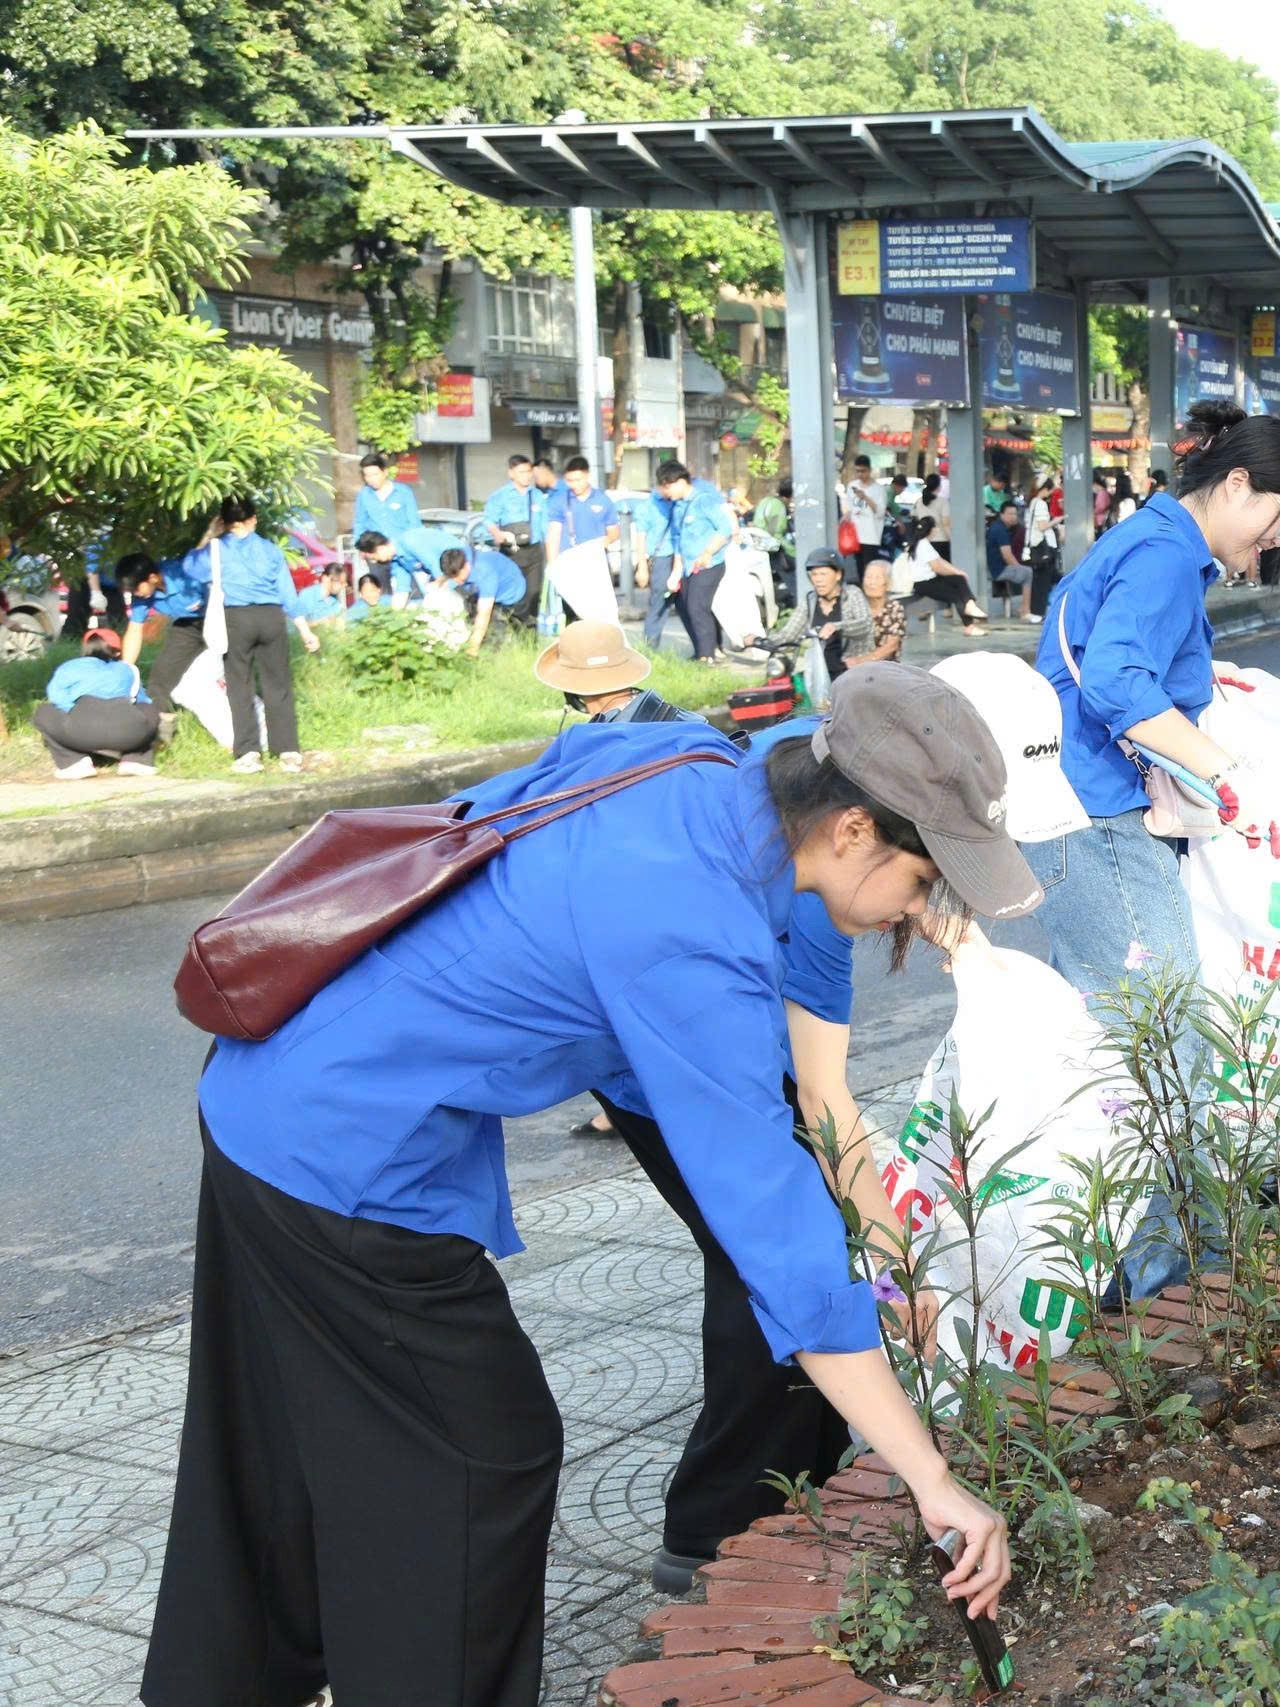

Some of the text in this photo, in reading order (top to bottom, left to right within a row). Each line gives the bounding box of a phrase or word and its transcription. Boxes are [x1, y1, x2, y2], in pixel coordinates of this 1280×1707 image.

[887, 235, 912, 244] TUYẾN
[993, 234, 1013, 243] PARK
[844, 266, 876, 280] E3.1
[232, 302, 270, 335] Lion
[272, 305, 323, 345] Cyber
[884, 301, 945, 330] CHUYÊN BIỆT
[886, 332, 960, 360] CHO PHÁI MẠNH
[1047, 326, 1062, 348] BIỆT
[1017, 350, 1034, 366] CHO
[1035, 349, 1051, 369] PHÁI
